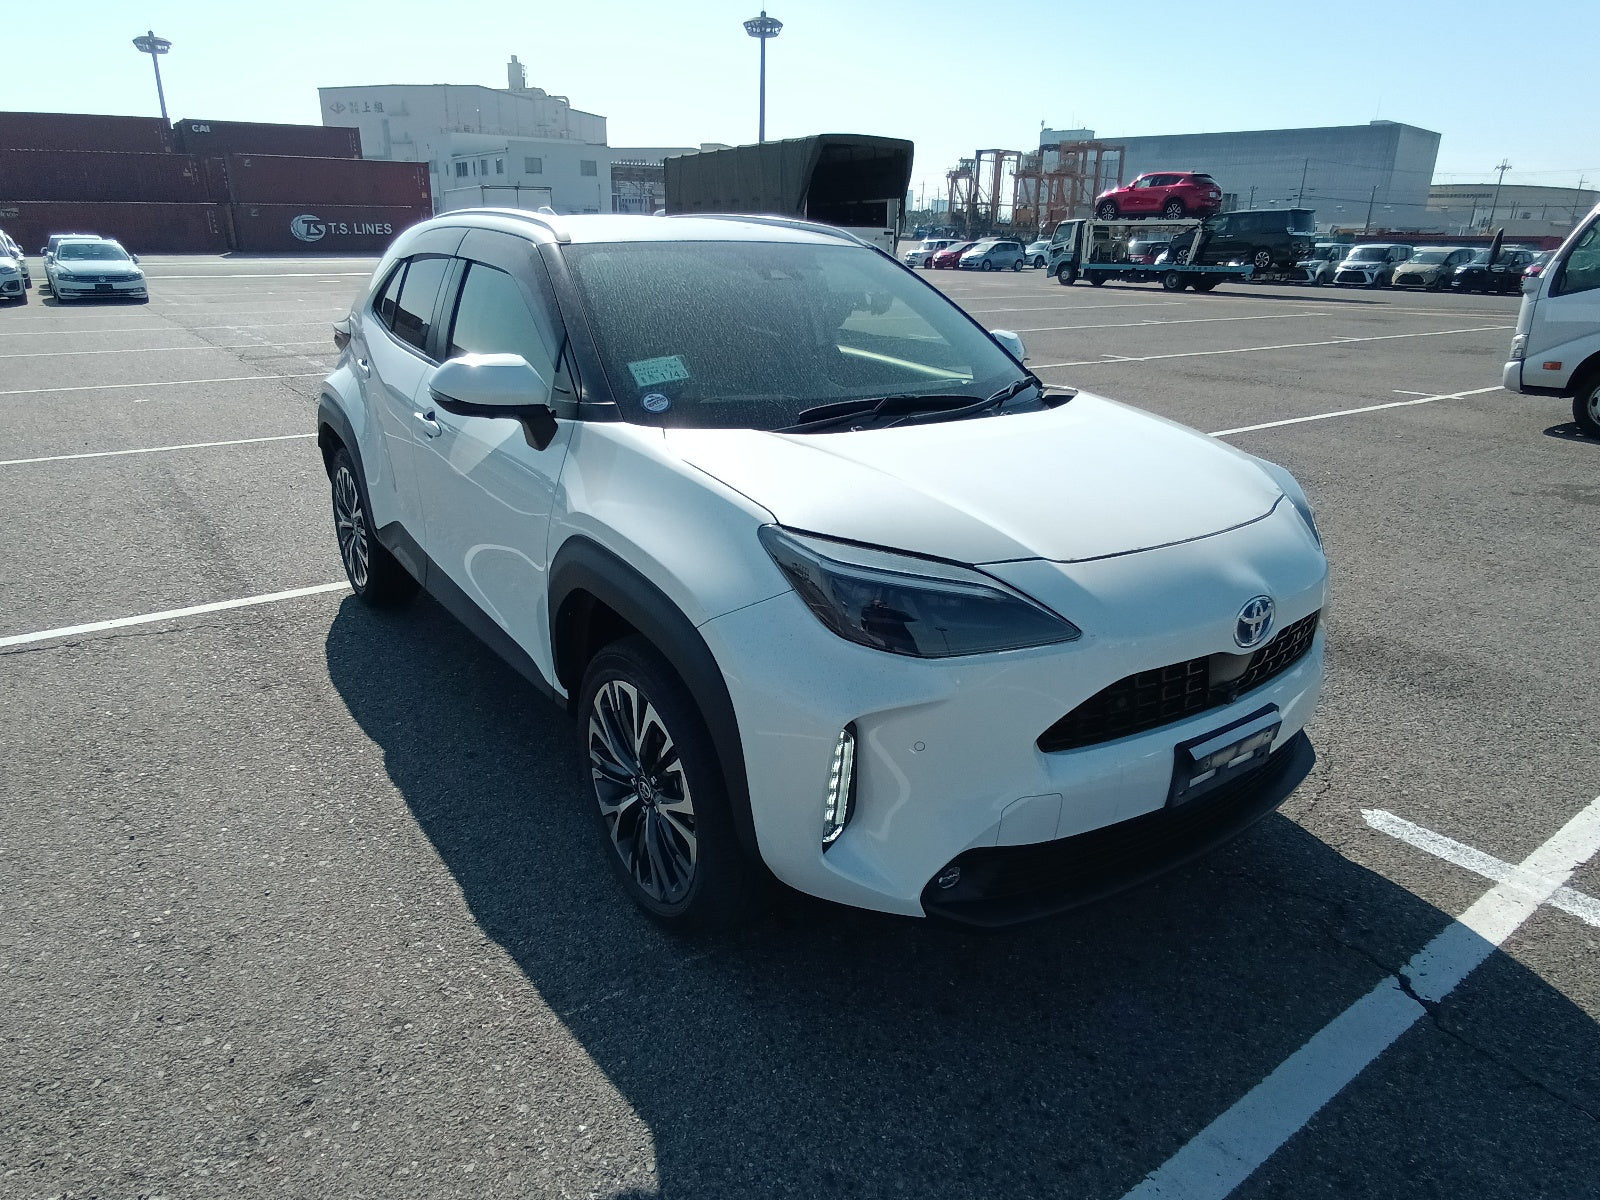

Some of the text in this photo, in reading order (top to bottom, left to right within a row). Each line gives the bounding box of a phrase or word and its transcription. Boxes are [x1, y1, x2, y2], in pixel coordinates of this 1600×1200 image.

[191, 124, 211, 133] CAI
[327, 222, 393, 235] T.S. LINES
